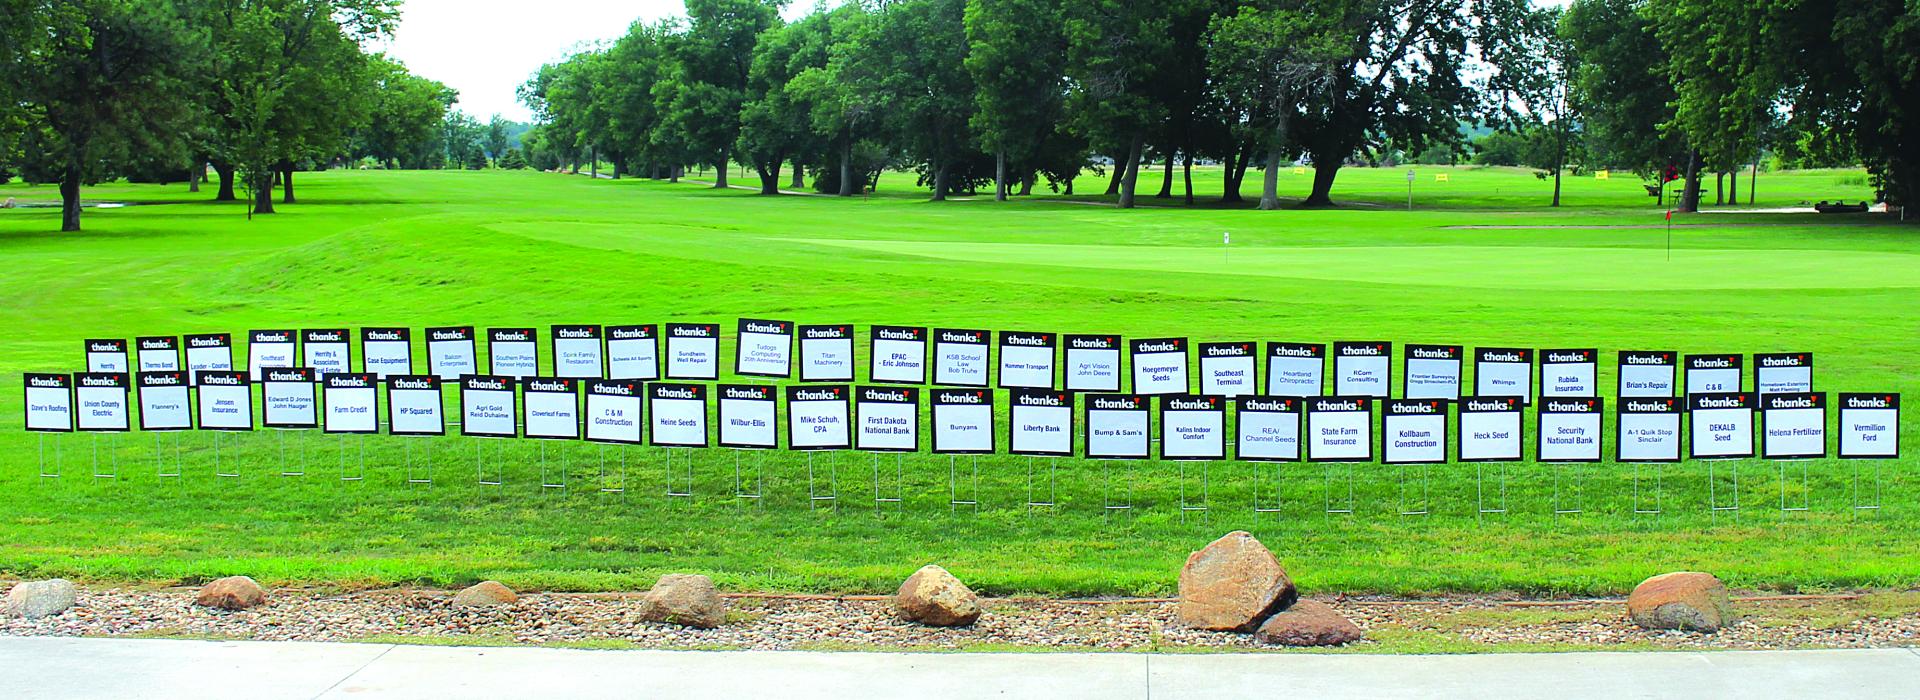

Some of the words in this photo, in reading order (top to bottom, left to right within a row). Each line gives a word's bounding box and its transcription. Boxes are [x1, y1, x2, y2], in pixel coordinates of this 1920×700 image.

[751, 350, 781, 358] Computing
[756, 357, 786, 365] Anniversary
[49, 405, 67, 413] Roofing
[595, 418, 632, 426] Construction
[731, 419, 765, 427] Wilbur-Ellis
[1558, 427, 1584, 435] Security
